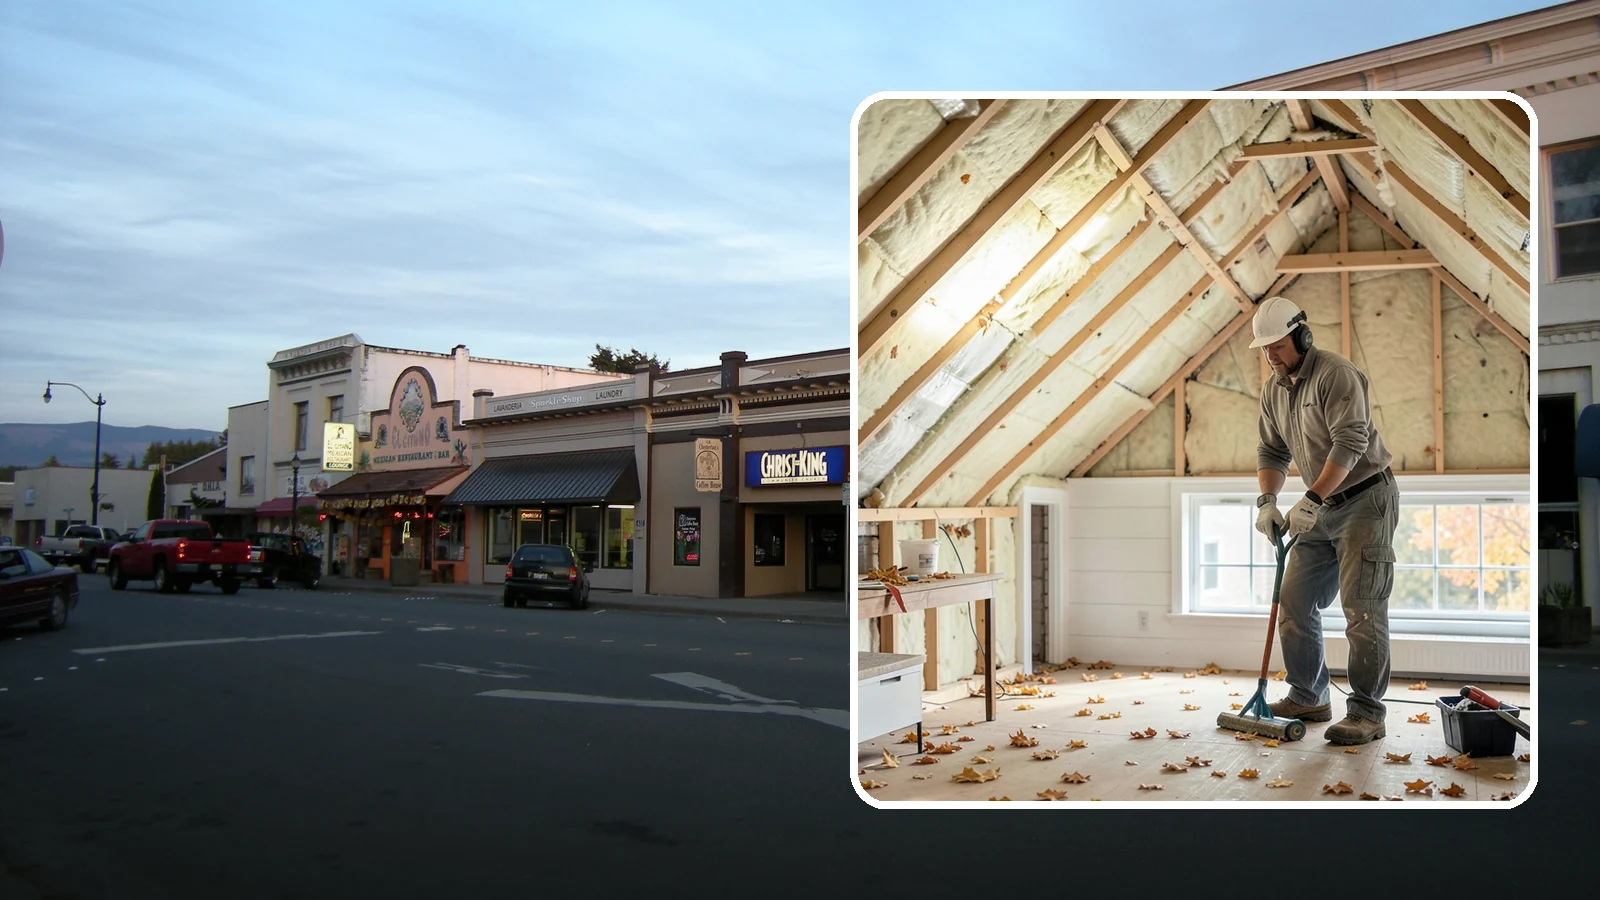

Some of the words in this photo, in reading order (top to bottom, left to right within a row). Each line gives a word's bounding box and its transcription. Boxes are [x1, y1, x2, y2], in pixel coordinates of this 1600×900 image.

[493, 402, 523, 412] LAVANDERIA
[562, 394, 583, 405] Shop
[595, 389, 624, 400] LAUNDRY
[373, 455, 396, 465] MEXICAN
[397, 451, 433, 463] RESTAURANT
[437, 450, 450, 460] BAR
[760, 452, 797, 478] CHRIST
[799, 450, 827, 476] KING
